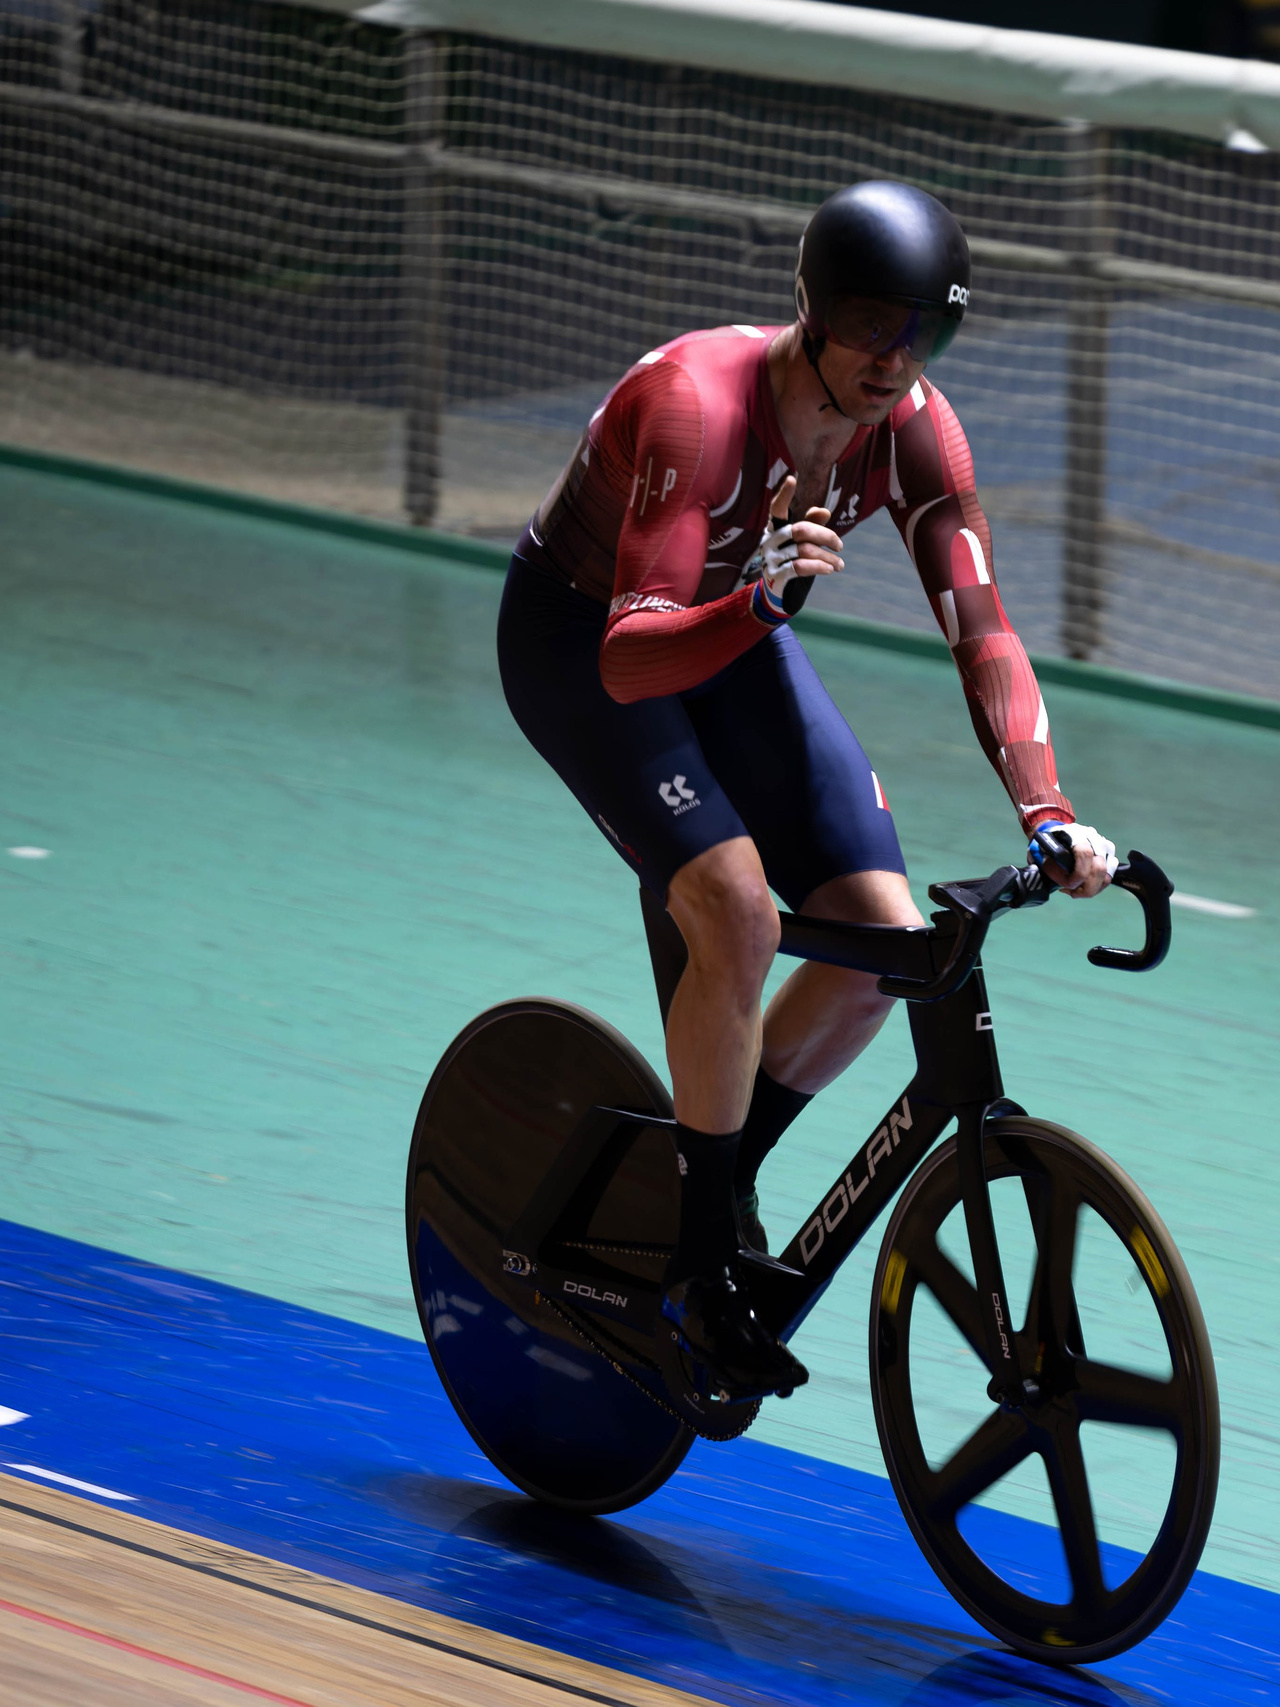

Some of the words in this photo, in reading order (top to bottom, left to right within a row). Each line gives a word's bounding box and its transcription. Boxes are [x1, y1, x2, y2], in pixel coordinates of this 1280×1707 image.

[799, 1095, 914, 1266] DOLAN
[563, 1280, 628, 1308] DOLAN
[991, 1292, 1012, 1360] DOLAN
